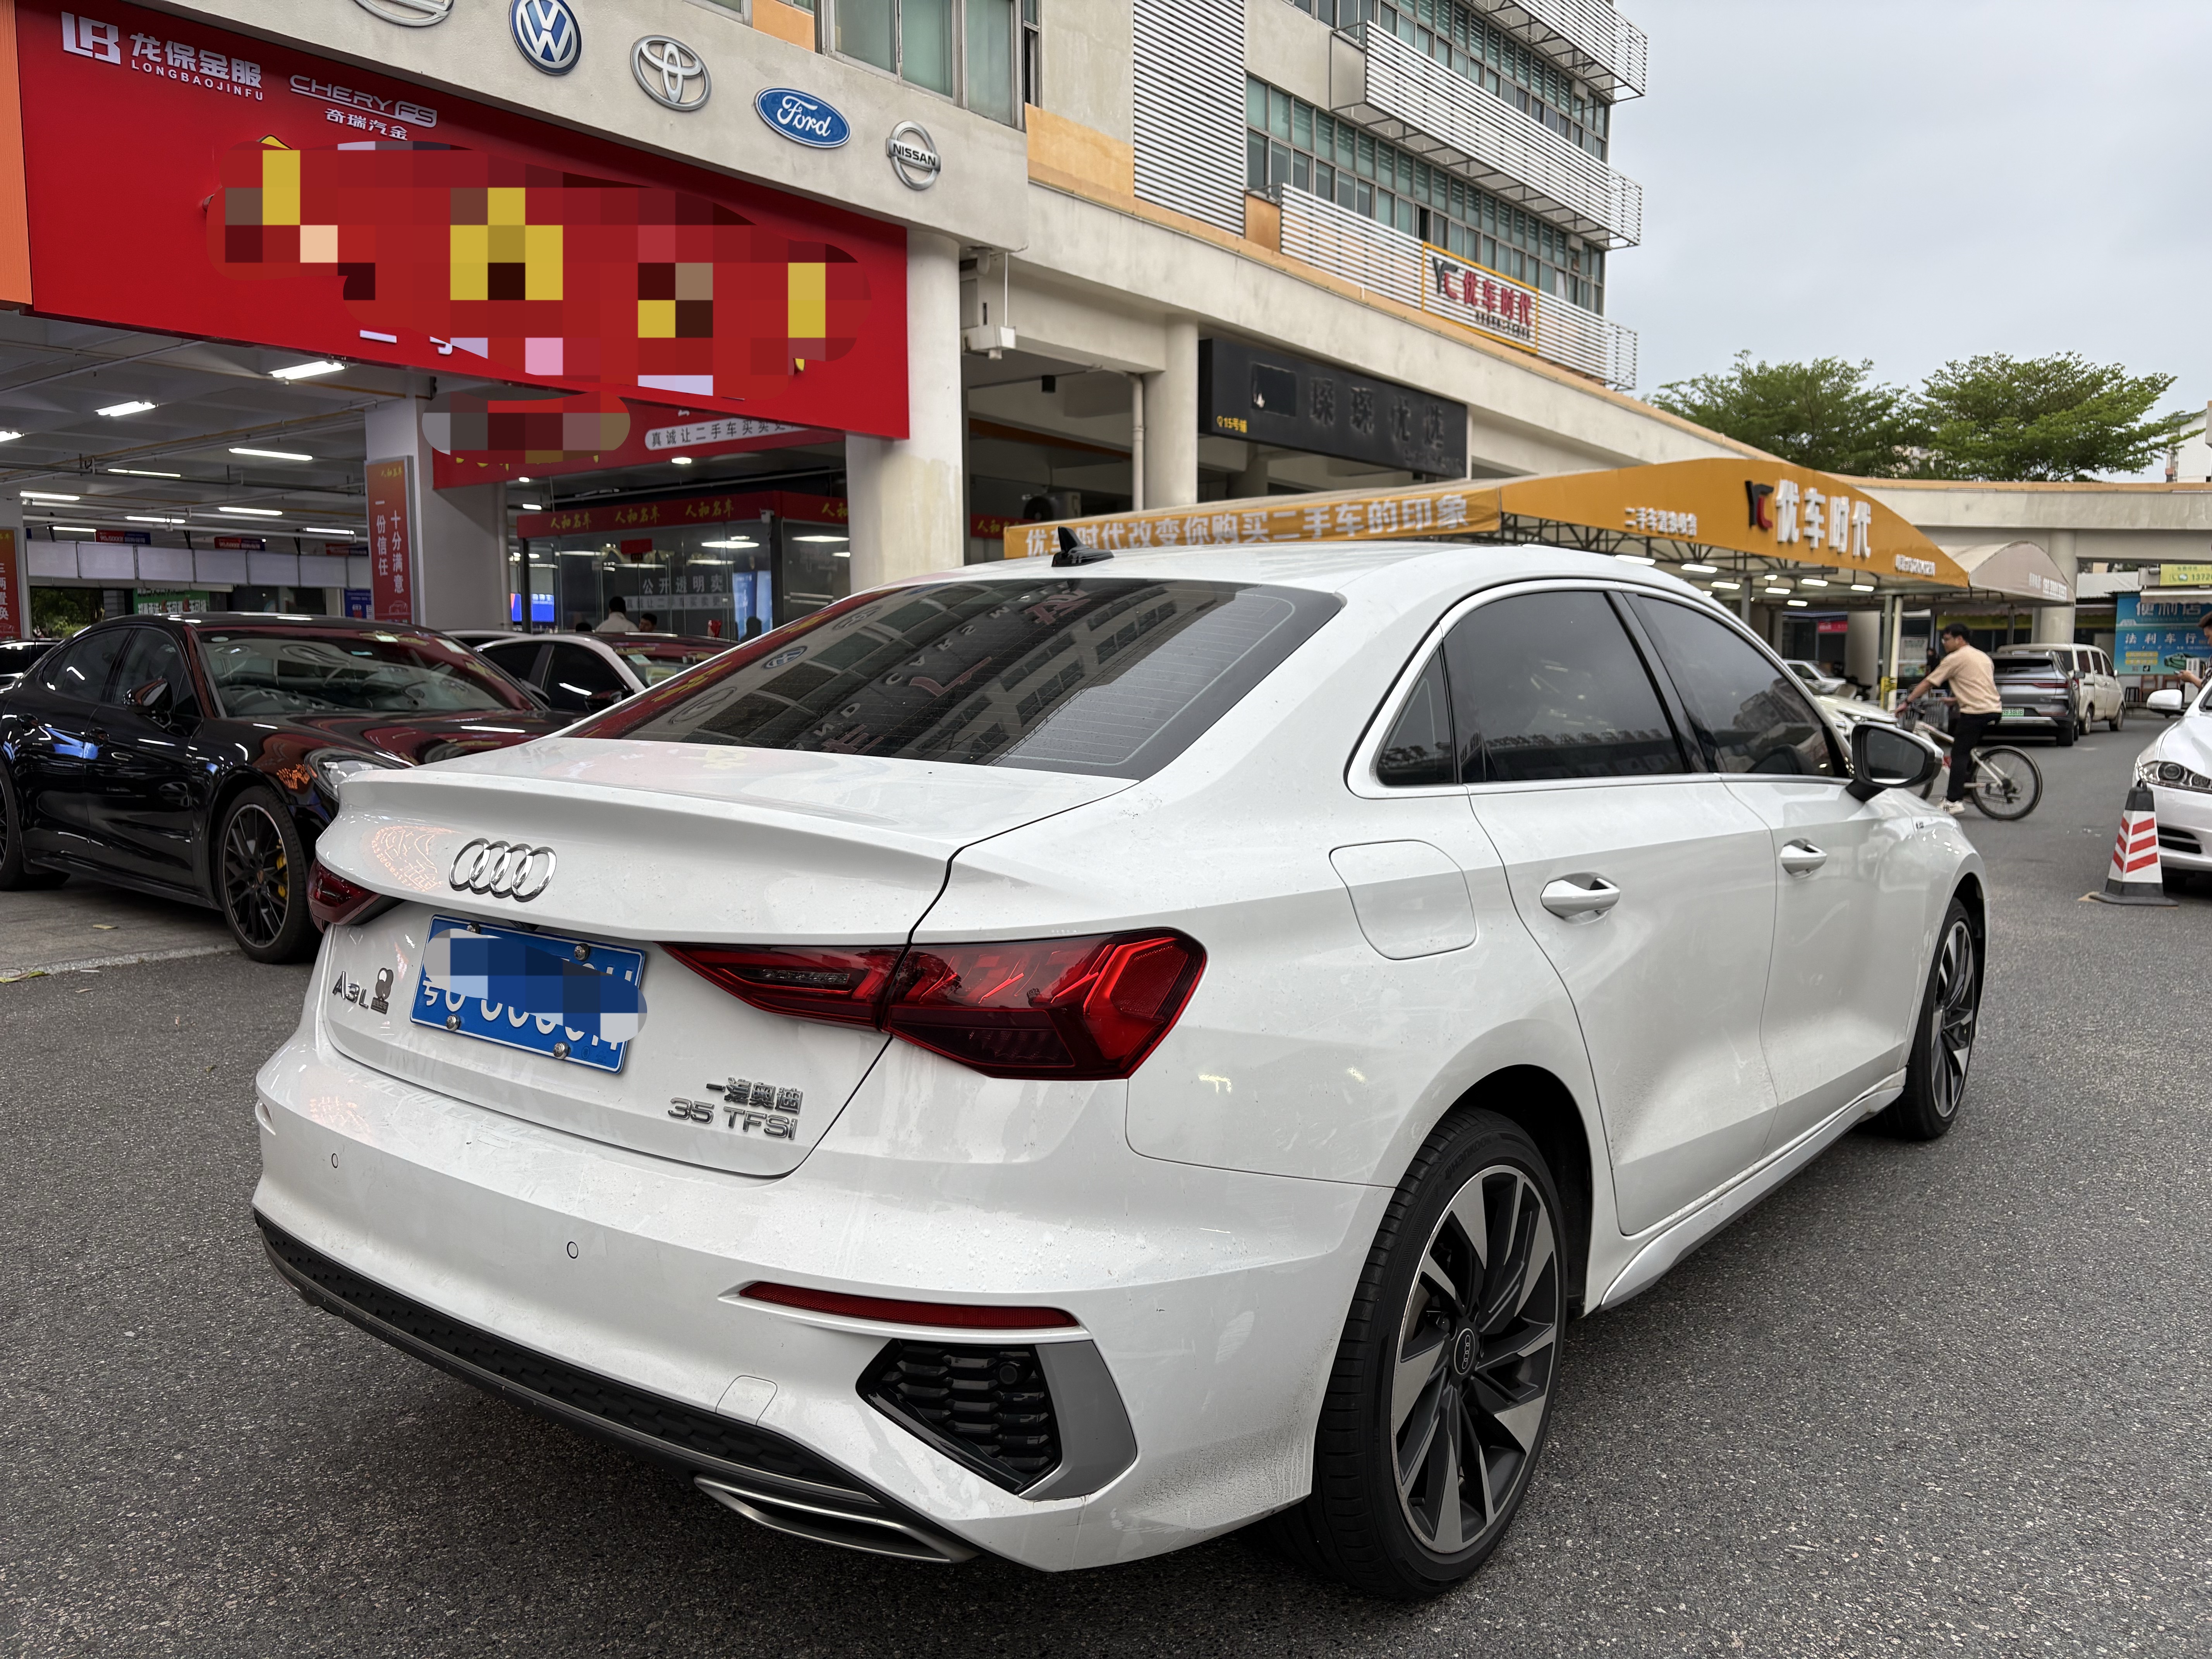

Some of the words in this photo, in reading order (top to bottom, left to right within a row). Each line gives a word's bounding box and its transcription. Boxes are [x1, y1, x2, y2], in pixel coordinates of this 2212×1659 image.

[130, 33, 262, 88] 龙保金服
[132, 60, 263, 101] LONGBAOJINFU
[290, 75, 393, 111] CHERY
[325, 108, 408, 141] 奇瑞汽金
[777, 96, 832, 137] Ford
[893, 143, 936, 166] NISSAN
[1463, 271, 1531, 326] 优车时代
[375, 500, 388, 576] 一份信任
[1776, 479, 1871, 558] 优车时代
[391, 510, 404, 594] 十分满意
[2126, 633, 2196, 644] 法利车行
[332, 971, 369, 1009] A3L
[668, 1097, 714, 1123] 35
[723, 1106, 798, 1140] TFSI
